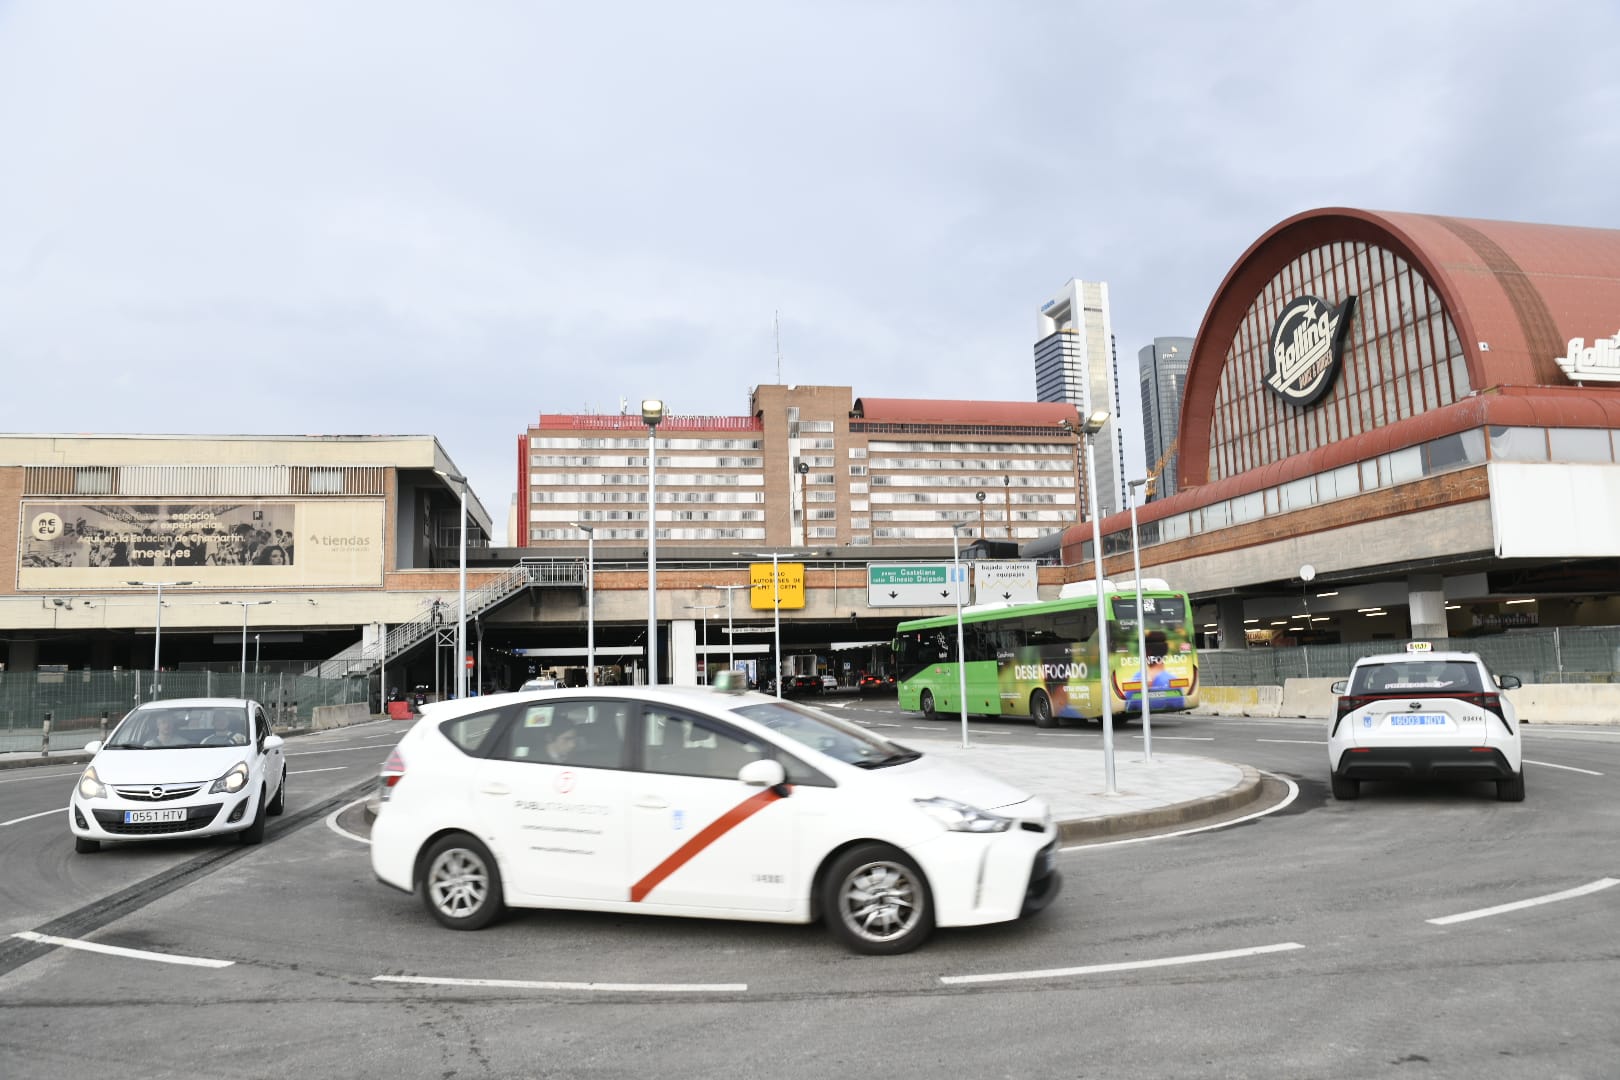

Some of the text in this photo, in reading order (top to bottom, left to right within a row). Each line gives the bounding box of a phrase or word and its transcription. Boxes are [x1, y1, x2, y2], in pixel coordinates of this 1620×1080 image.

[1270, 311, 1332, 386] Rolling
[1560, 334, 1620, 377] Rolli
[131, 534, 172, 543] Estación
[175, 534, 187, 543] de
[322, 535, 370, 546] tiendas
[900, 568, 936, 576] Castellana
[889, 575, 914, 583] Sinesio
[916, 575, 945, 583] Delgado
[1014, 662, 1088, 680] DESENFOCADO
[132, 810, 184, 822] 0551 HTV
